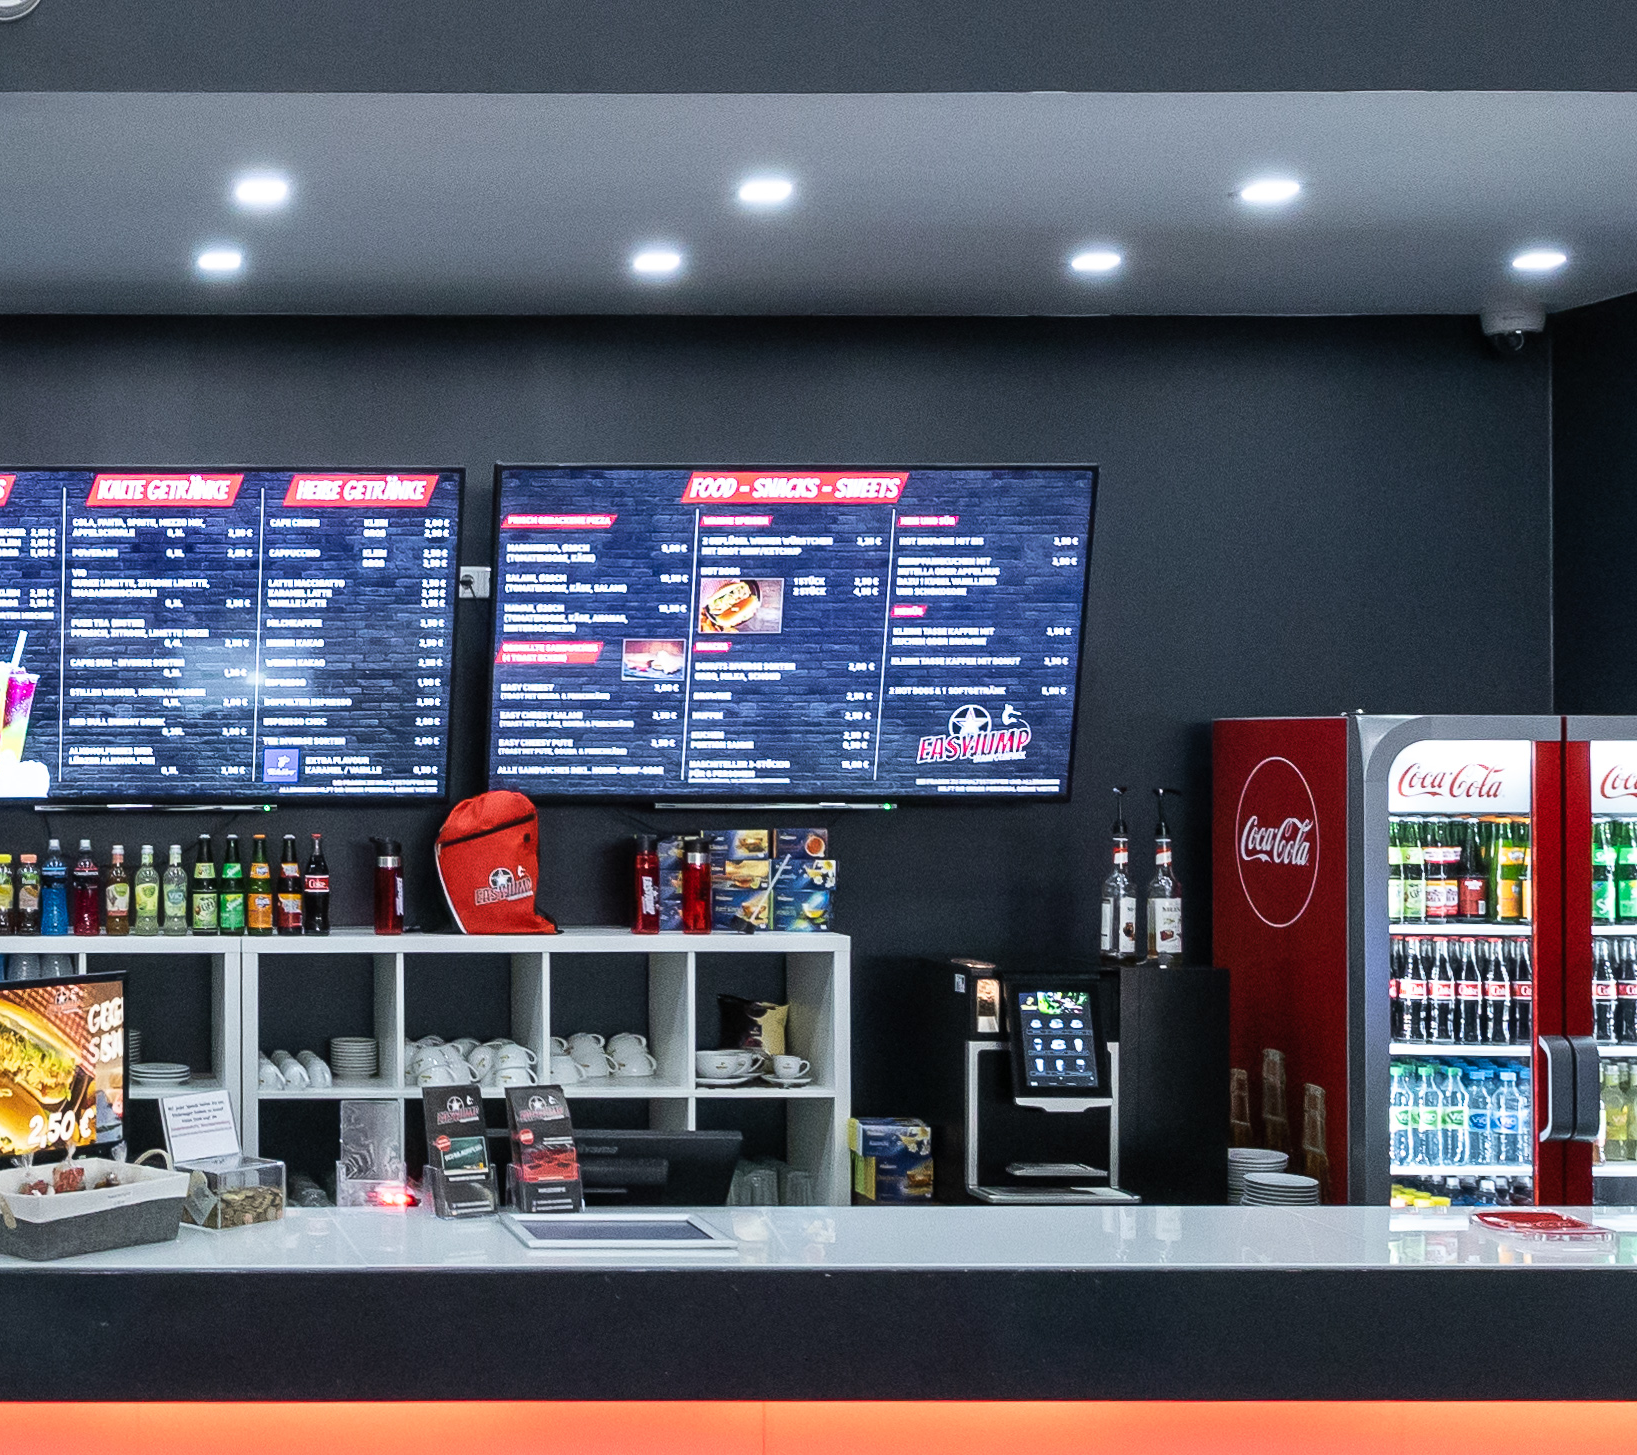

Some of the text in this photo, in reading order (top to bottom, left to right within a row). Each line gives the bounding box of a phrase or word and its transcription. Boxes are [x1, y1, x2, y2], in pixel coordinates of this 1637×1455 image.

[97, 475, 230, 500] KALTE GETRÄNKE
[343, 475, 426, 500] GETRÄNKE
[690, 477, 737, 498] FOOD
[752, 478, 820, 498] SNACKS
[835, 478, 901, 498] SWEETS
[916, 728, 1031, 764] EASYJUMP
[1398, 763, 1504, 798] Coca-Cola
[1241, 816, 1313, 865] Coca-Cola
[28, 1108, 95, 1148] 2,50 €
